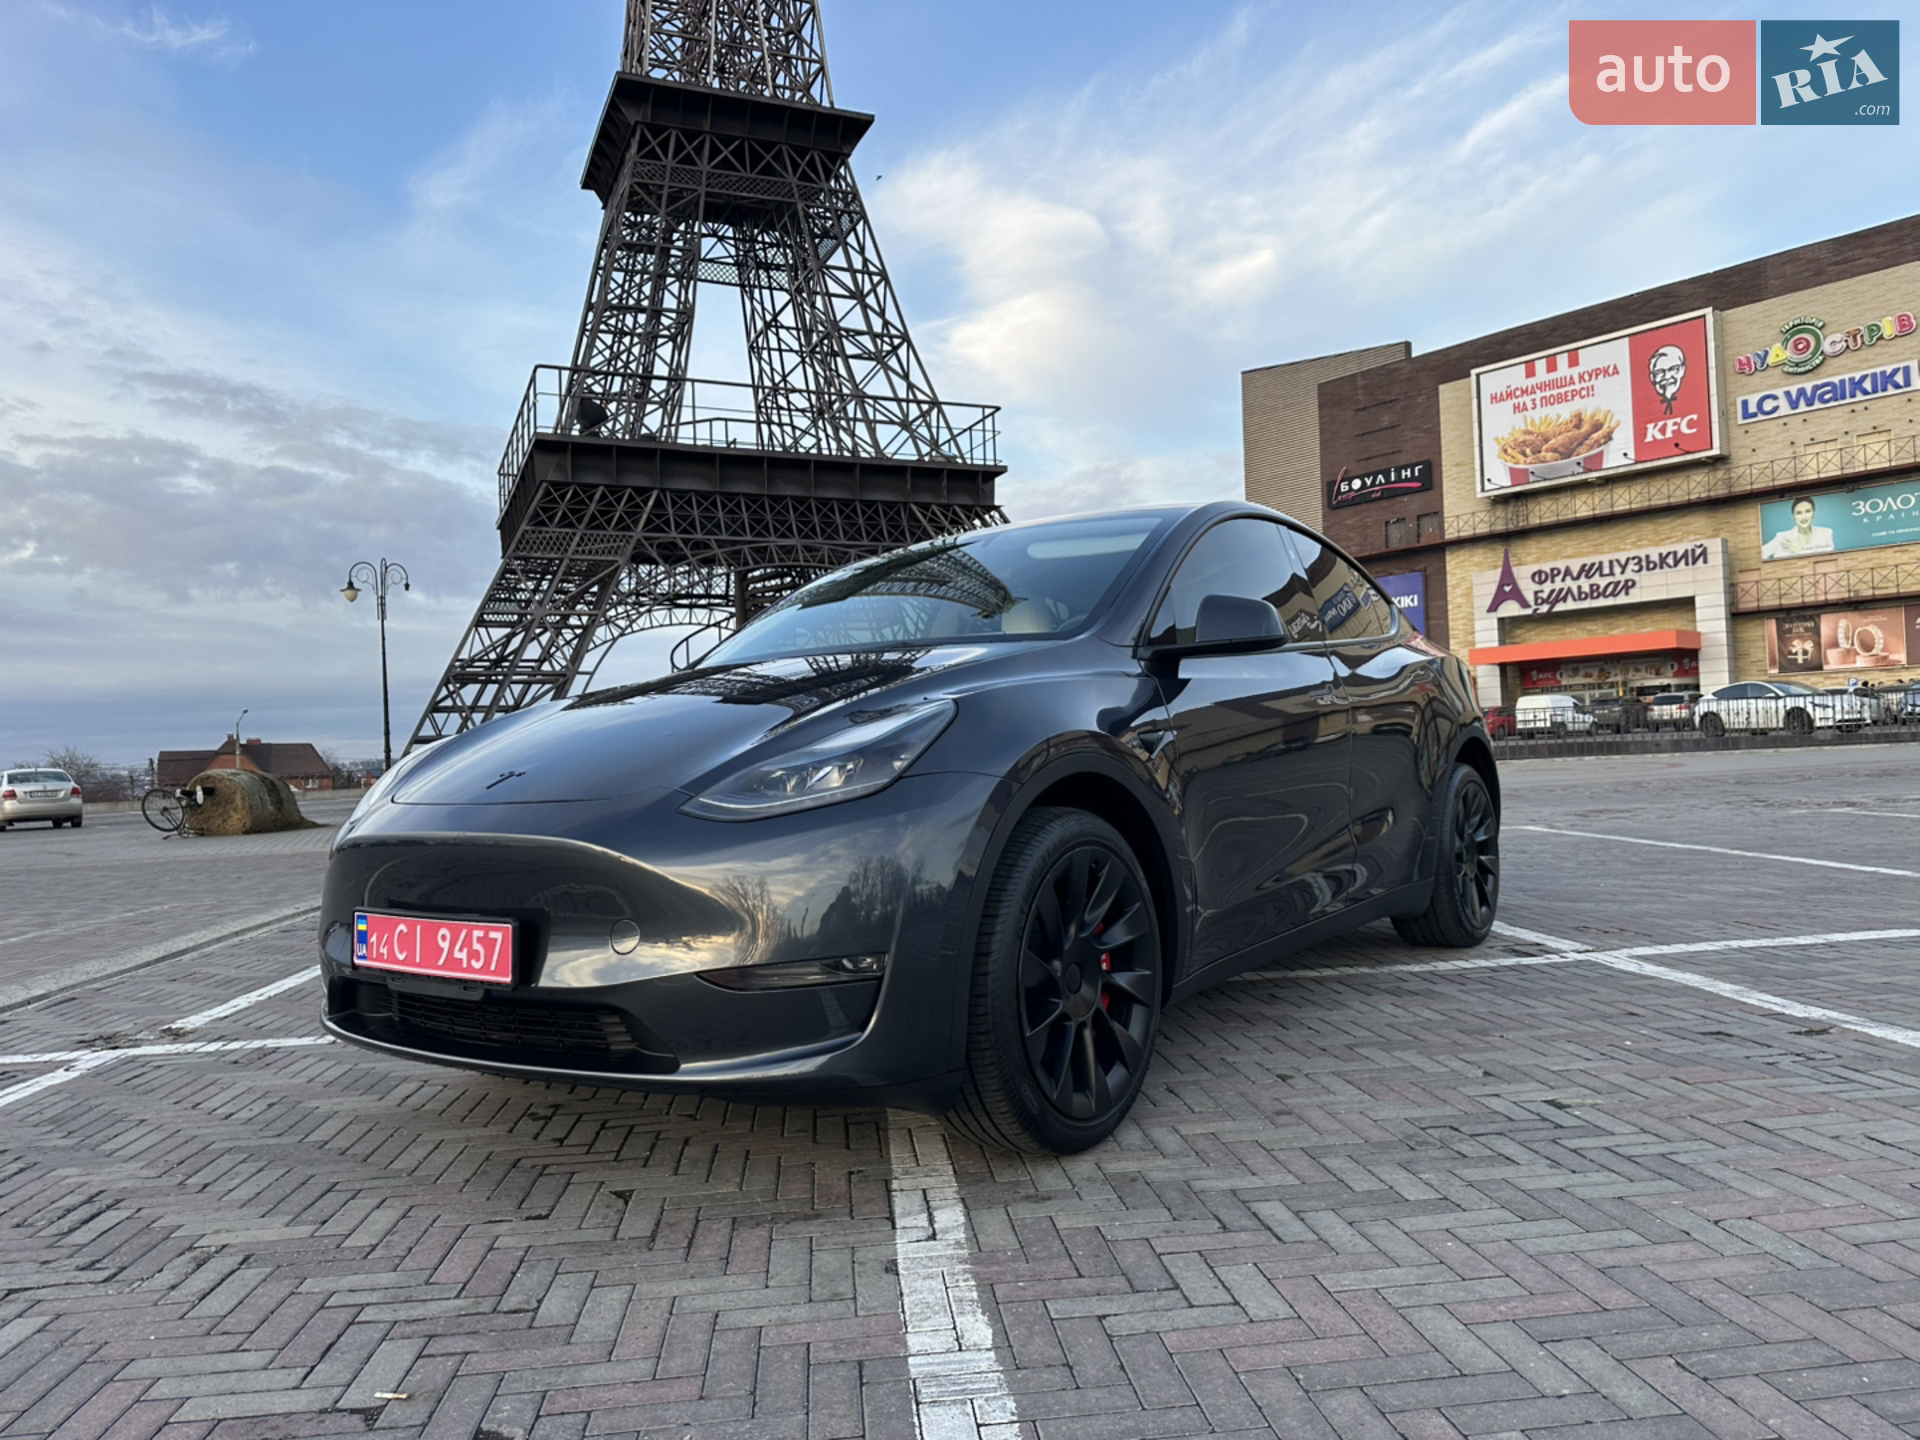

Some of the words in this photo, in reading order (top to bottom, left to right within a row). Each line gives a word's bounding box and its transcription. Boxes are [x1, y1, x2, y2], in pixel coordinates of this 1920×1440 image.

[1489, 374, 1576, 405] НАЙСМАЧНІША
[1578, 363, 1620, 385] КУРКА
[1513, 400, 1529, 415] НА
[1530, 398, 1537, 411] 3
[1540, 385, 1595, 409] ПОВЕРСІ!
[1741, 394, 1780, 420] LC
[1643, 414, 1698, 443] KFC
[1530, 543, 1709, 586] ФРАНЦУЗЬКИЙ
[356, 943, 368, 957] UA
[436, 927, 503, 971] 9457
